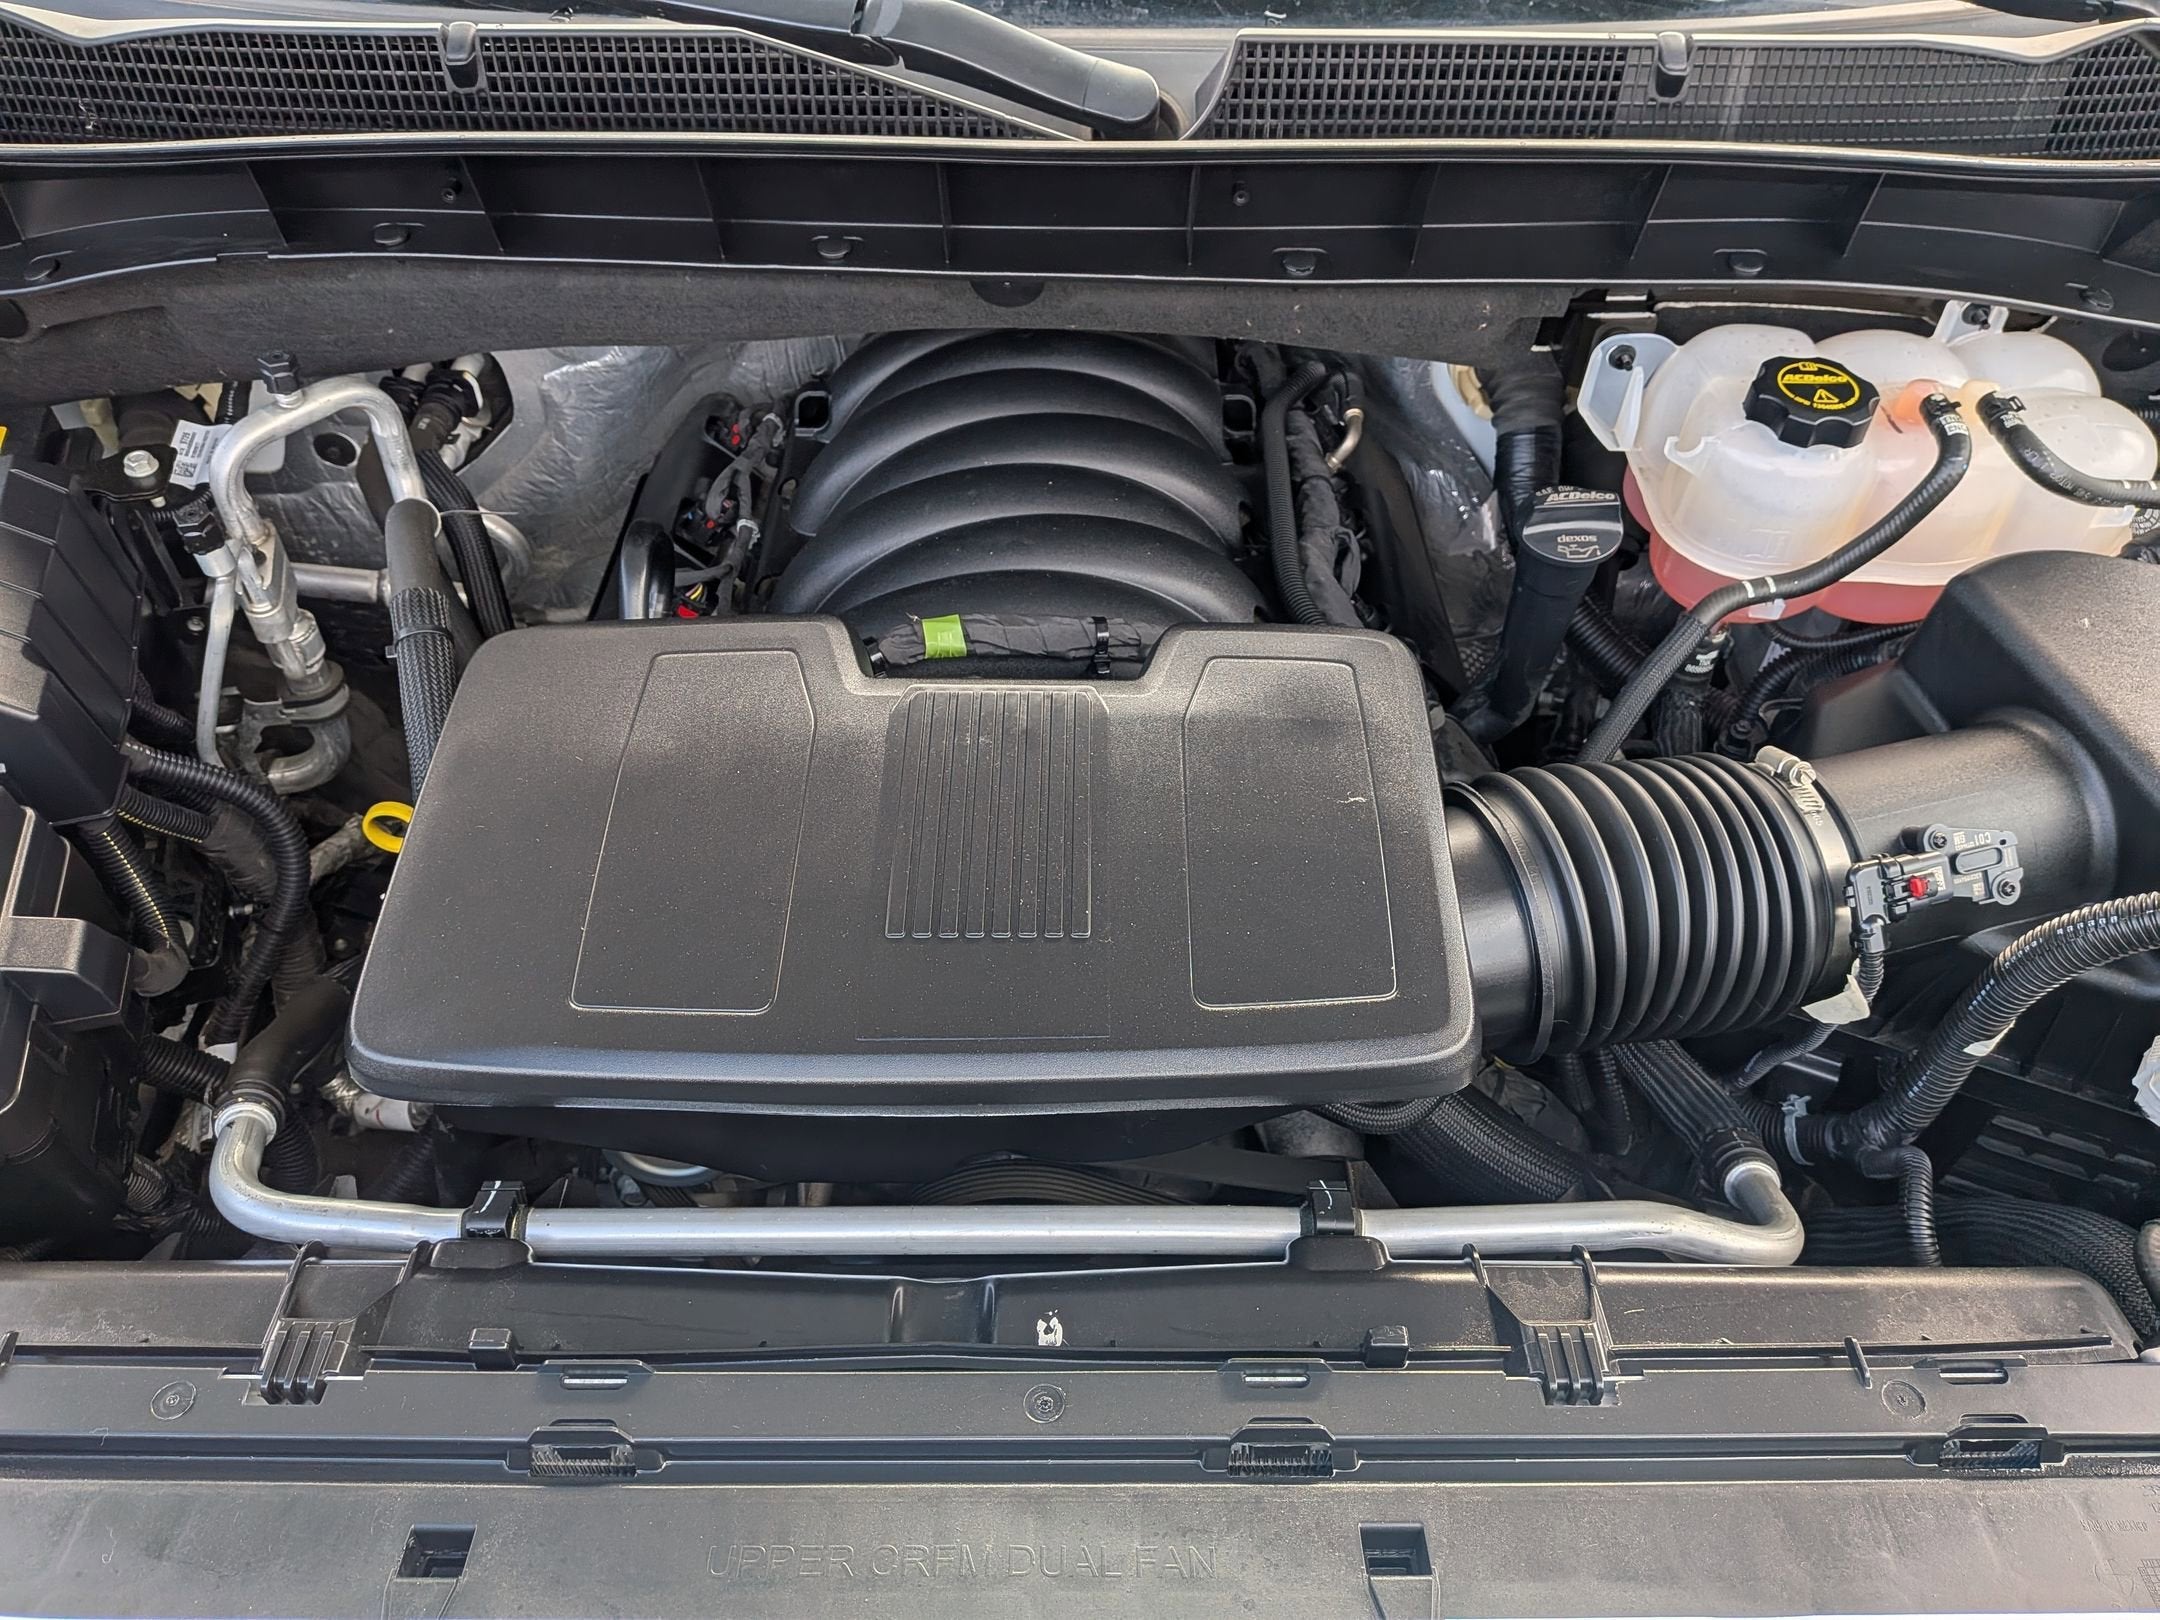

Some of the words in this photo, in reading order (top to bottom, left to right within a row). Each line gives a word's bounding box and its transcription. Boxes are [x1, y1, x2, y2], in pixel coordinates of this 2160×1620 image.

[1782, 374, 1849, 384] ACDelco
[1544, 491, 1616, 502] ACDelco
[1556, 534, 1598, 543] dexos
[706, 1544, 855, 1577] UPPER
[1007, 1544, 1123, 1577] DUAL
[1135, 1544, 1218, 1577] FAN
